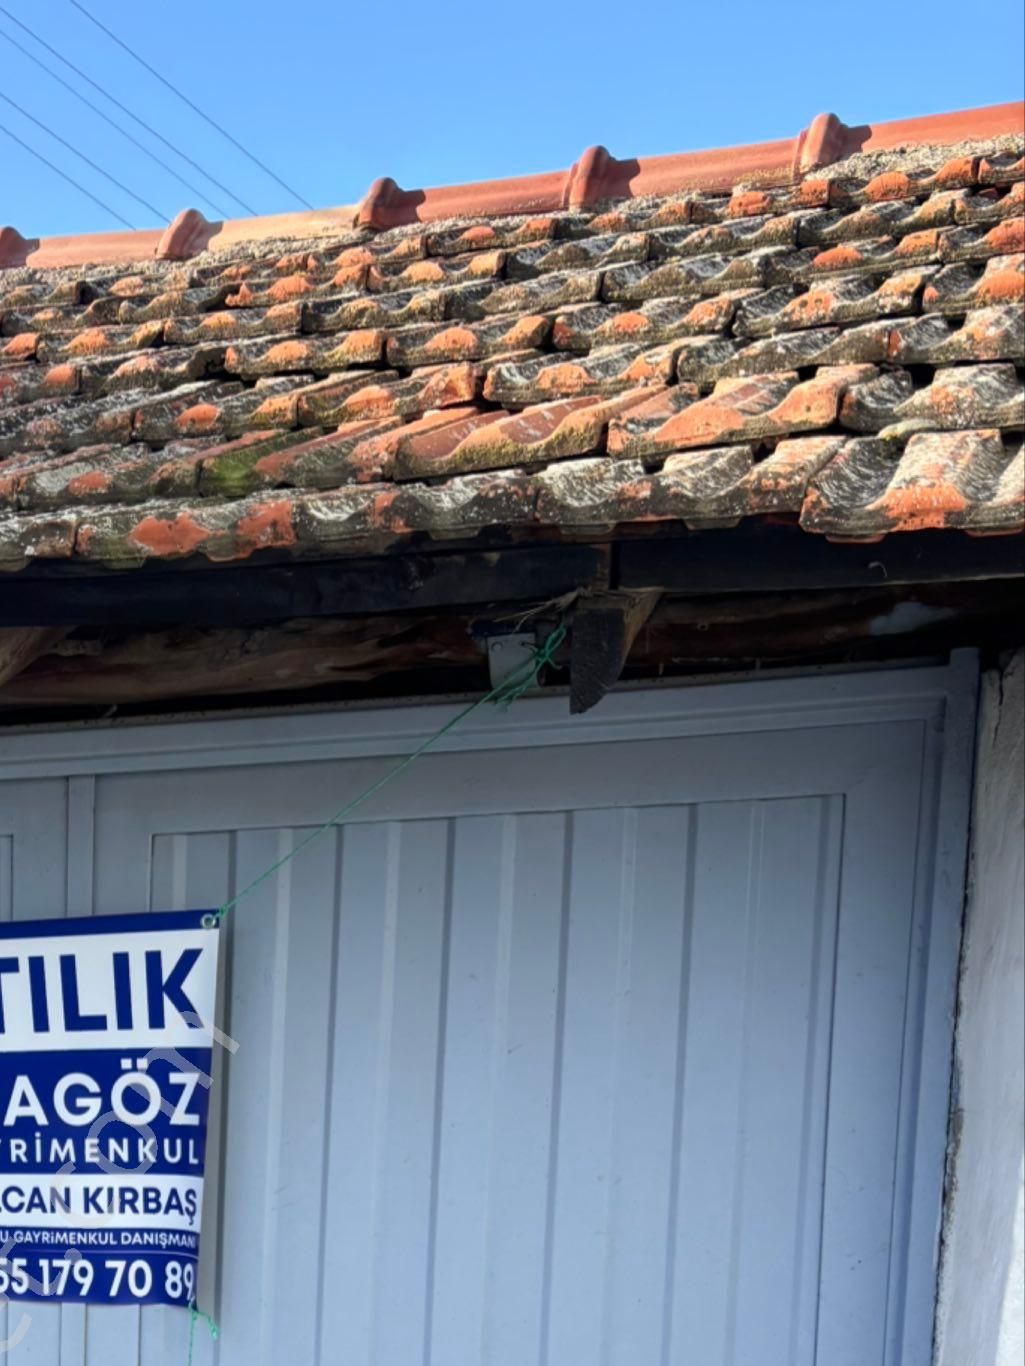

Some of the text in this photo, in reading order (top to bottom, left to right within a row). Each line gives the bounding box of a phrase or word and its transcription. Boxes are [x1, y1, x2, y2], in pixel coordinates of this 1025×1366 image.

[83, 1187, 197, 1226] KIRBAŞ
[38, 1259, 94, 1297] 179
[105, 1259, 153, 1298] 70
[165, 1260, 193, 1300] 89
